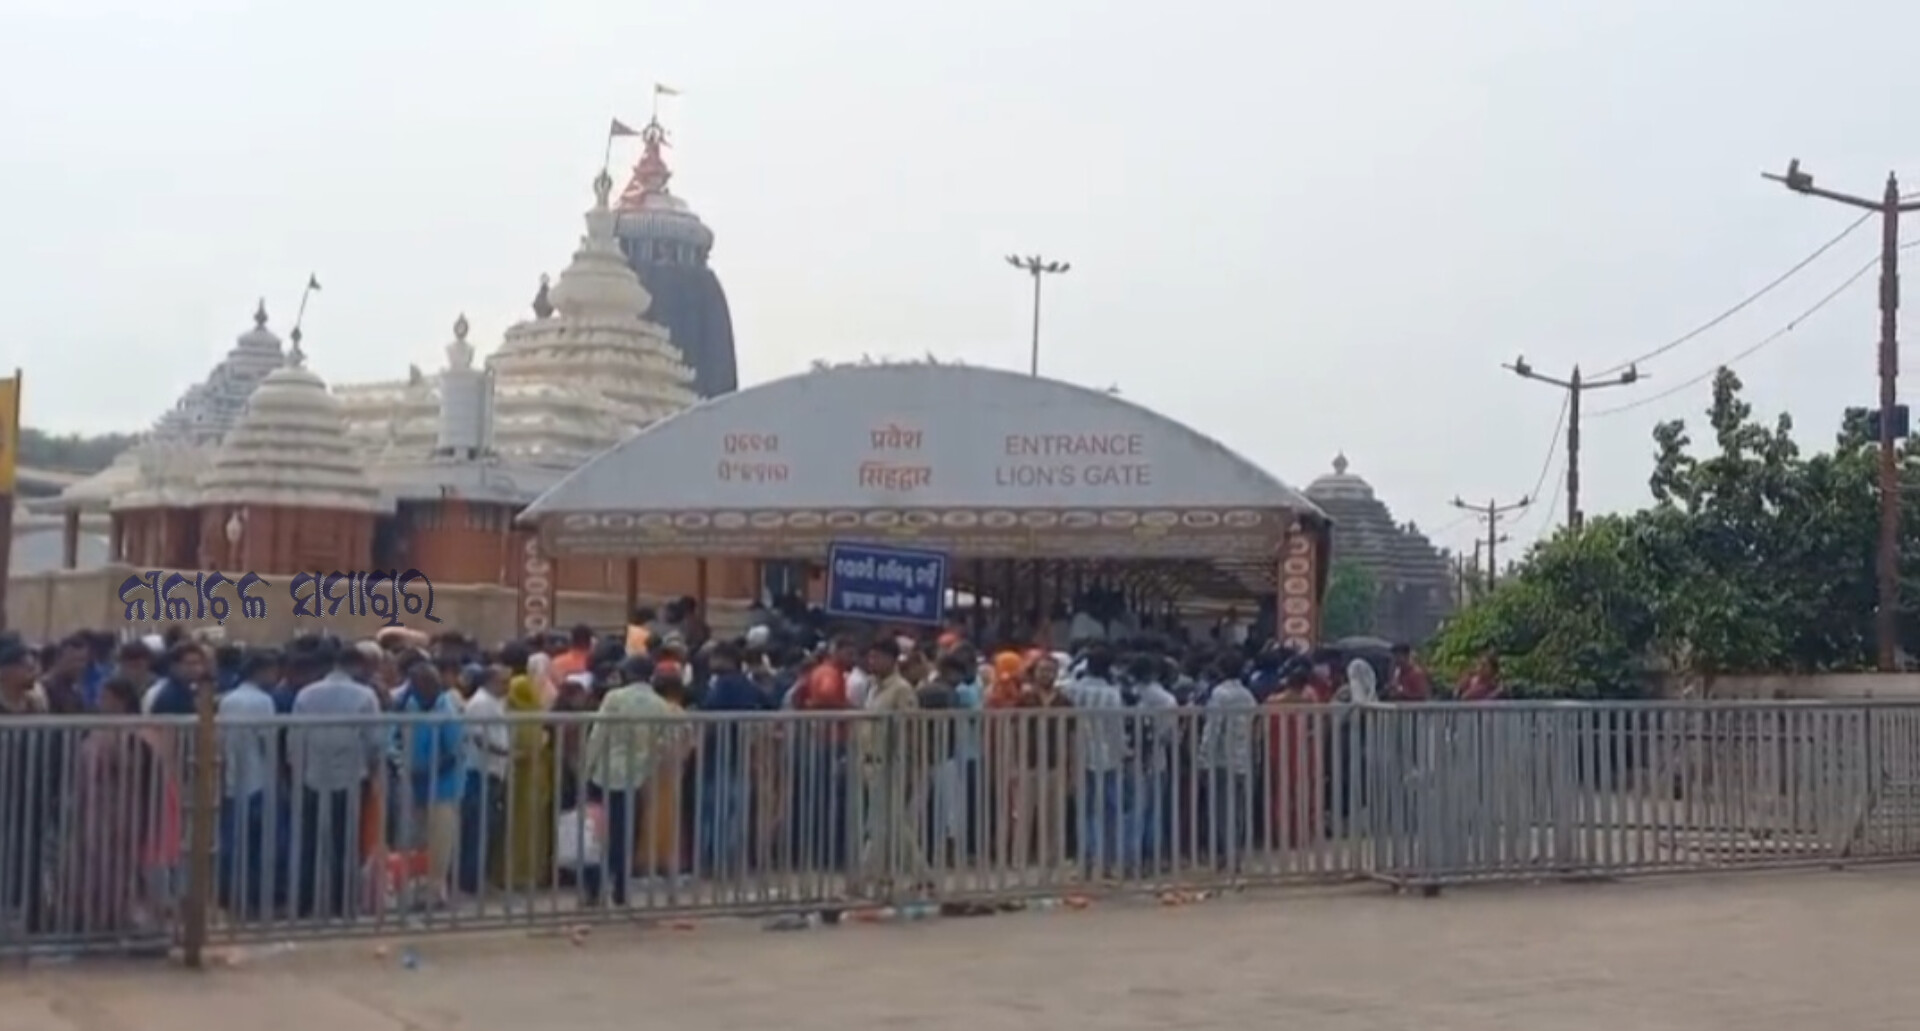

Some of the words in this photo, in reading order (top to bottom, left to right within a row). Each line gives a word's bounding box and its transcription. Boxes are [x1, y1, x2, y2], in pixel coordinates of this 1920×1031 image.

[871, 424, 923, 450] प्रवेश
[1005, 434, 1143, 455] ENTRANCE
[995, 464, 1076, 487] LION'S
[1083, 463, 1152, 486] GATE
